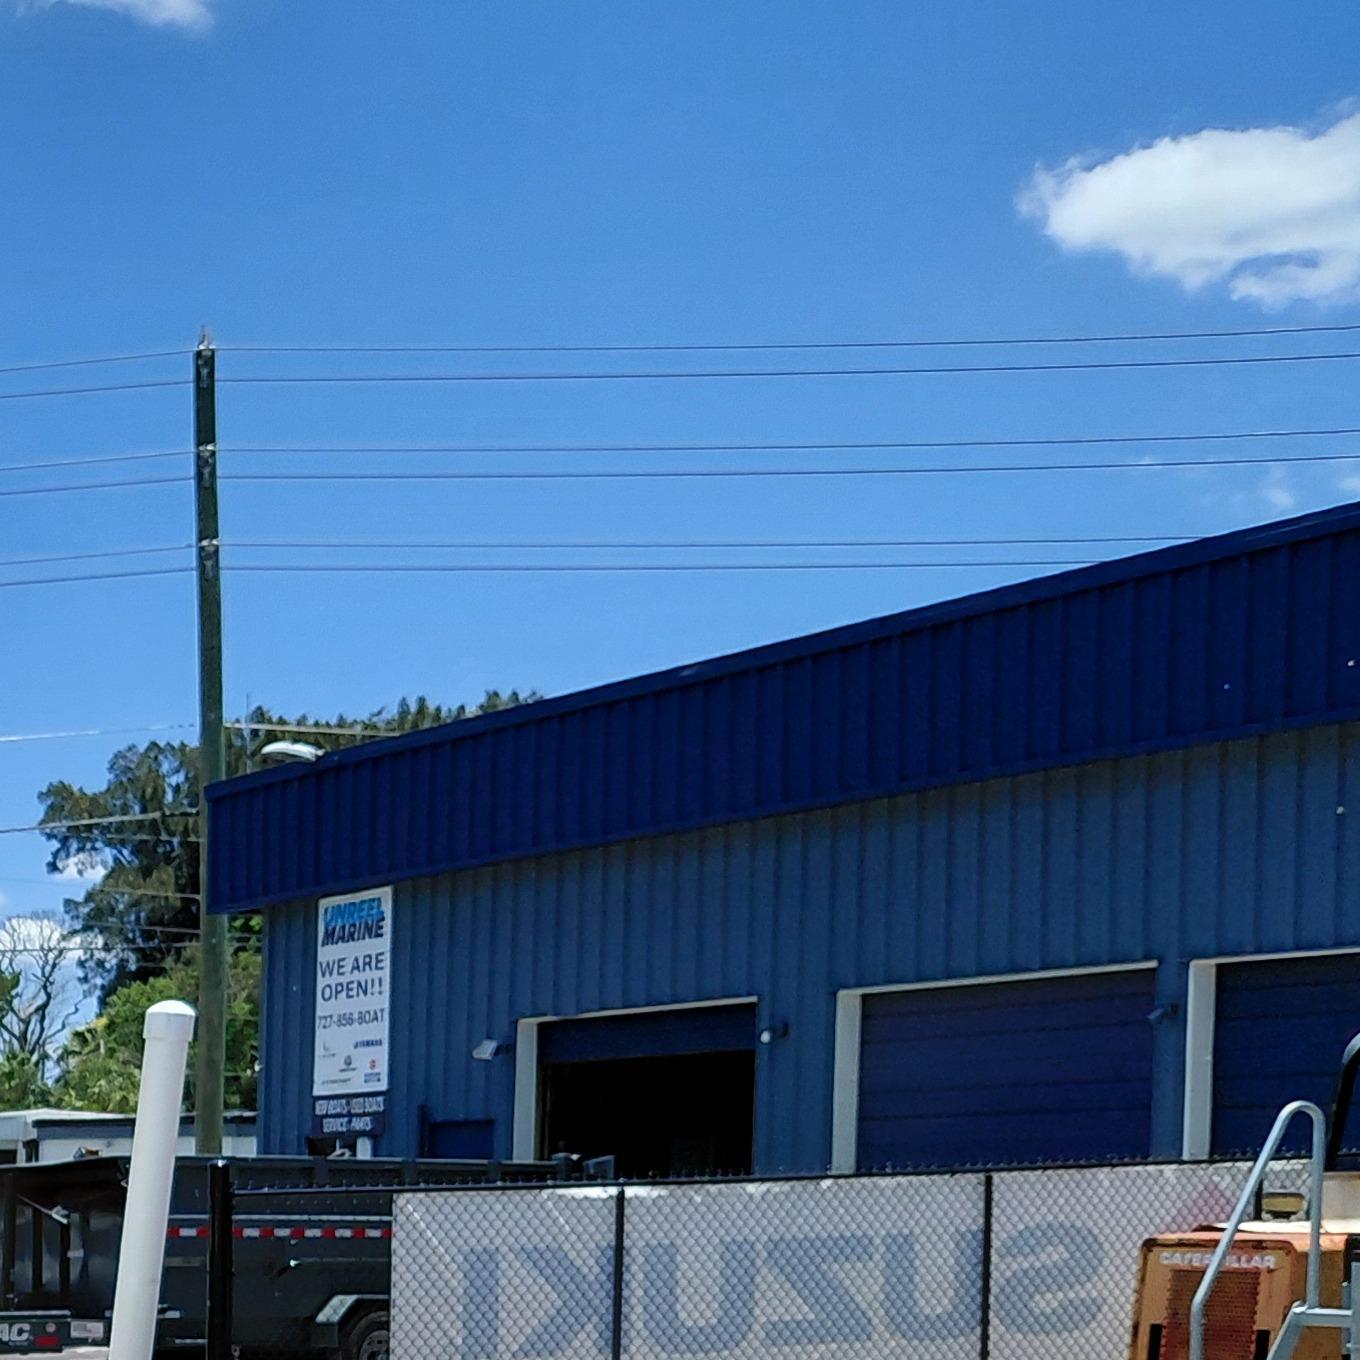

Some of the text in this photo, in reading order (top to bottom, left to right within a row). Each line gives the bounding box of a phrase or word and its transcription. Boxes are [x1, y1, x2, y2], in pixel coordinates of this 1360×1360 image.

[323, 897, 384, 927] UNREEL
[321, 917, 386, 948] MARINE
[319, 952, 385, 978] WE ARE
[321, 977, 384, 1002] OPEN!!
